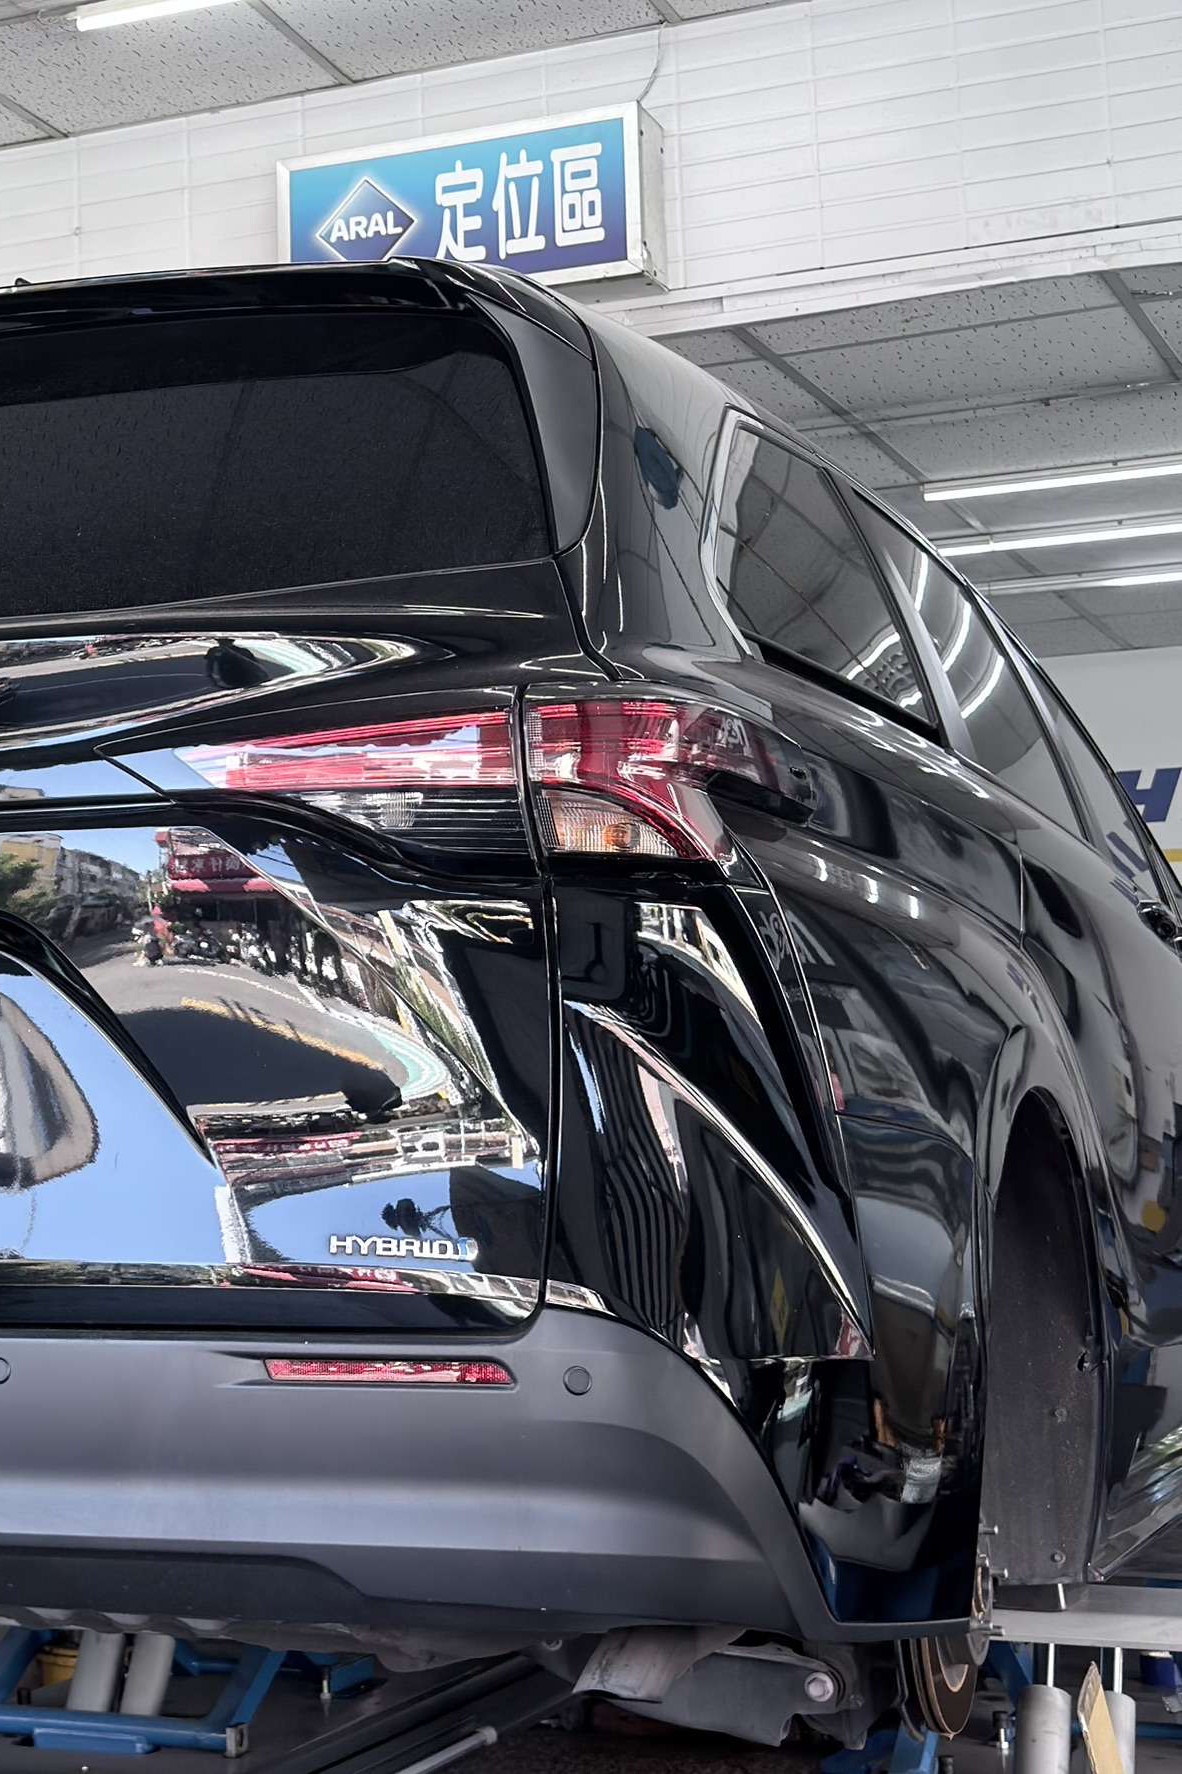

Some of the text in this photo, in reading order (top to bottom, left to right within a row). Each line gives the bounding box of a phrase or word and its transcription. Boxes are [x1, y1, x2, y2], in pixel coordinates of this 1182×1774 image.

[435, 142, 606, 262] 定位區
[329, 210, 403, 244] ARAL
[329, 1234, 455, 1260] HYBRID
